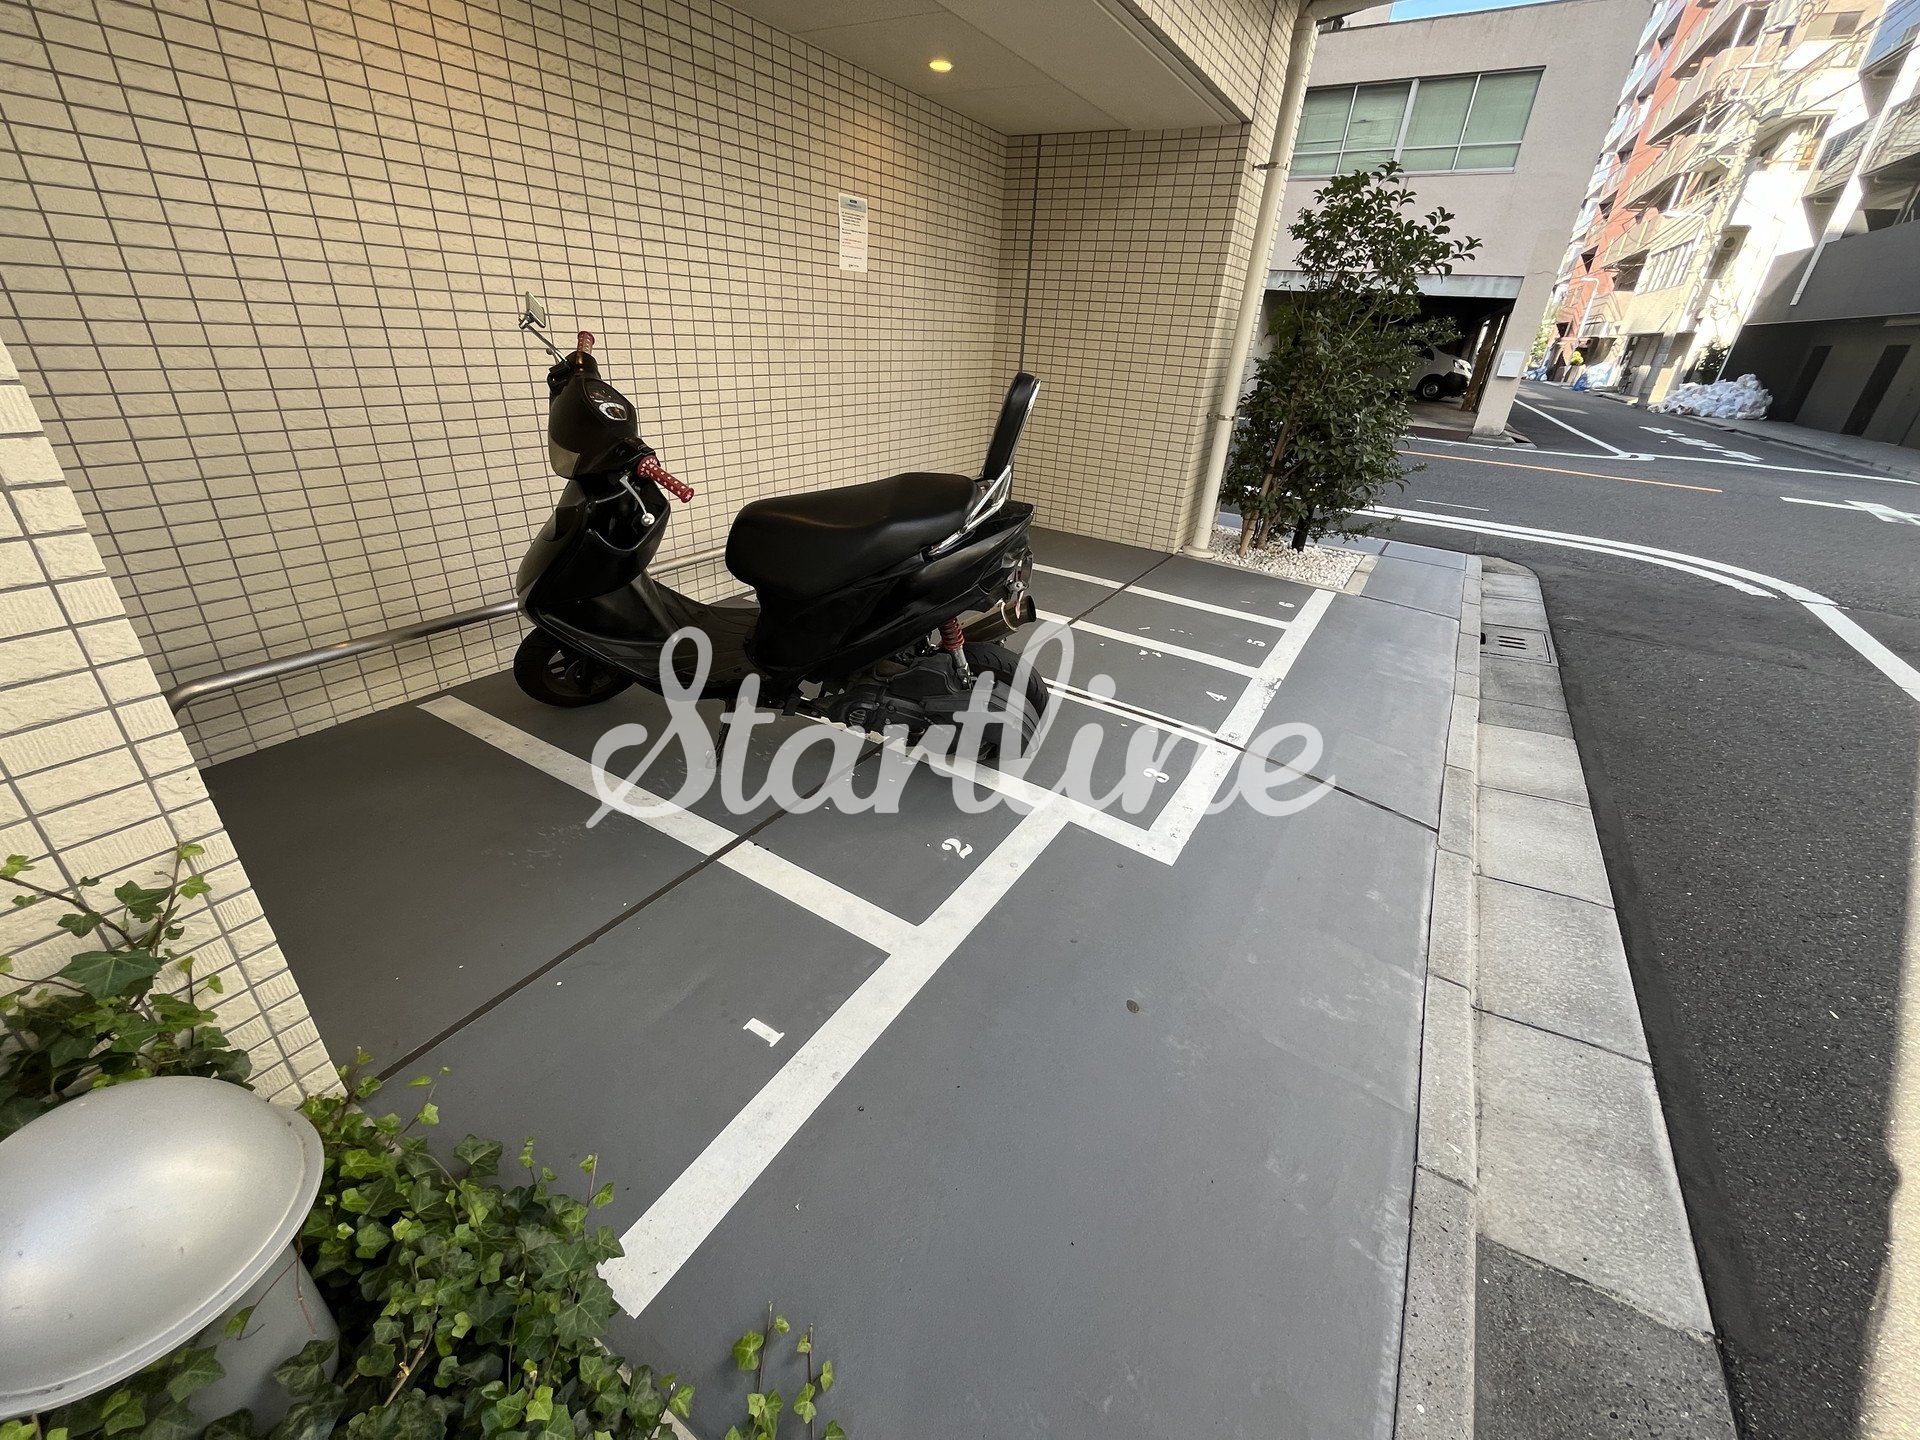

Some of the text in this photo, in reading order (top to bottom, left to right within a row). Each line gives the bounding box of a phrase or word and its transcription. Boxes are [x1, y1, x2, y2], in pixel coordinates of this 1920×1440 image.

[1246, 638, 1266, 647] 5
[1206, 691, 1228, 702] 4
[1143, 767, 1170, 784] 3
[941, 838, 973, 859] 2
[742, 1017, 785, 1047] 1
